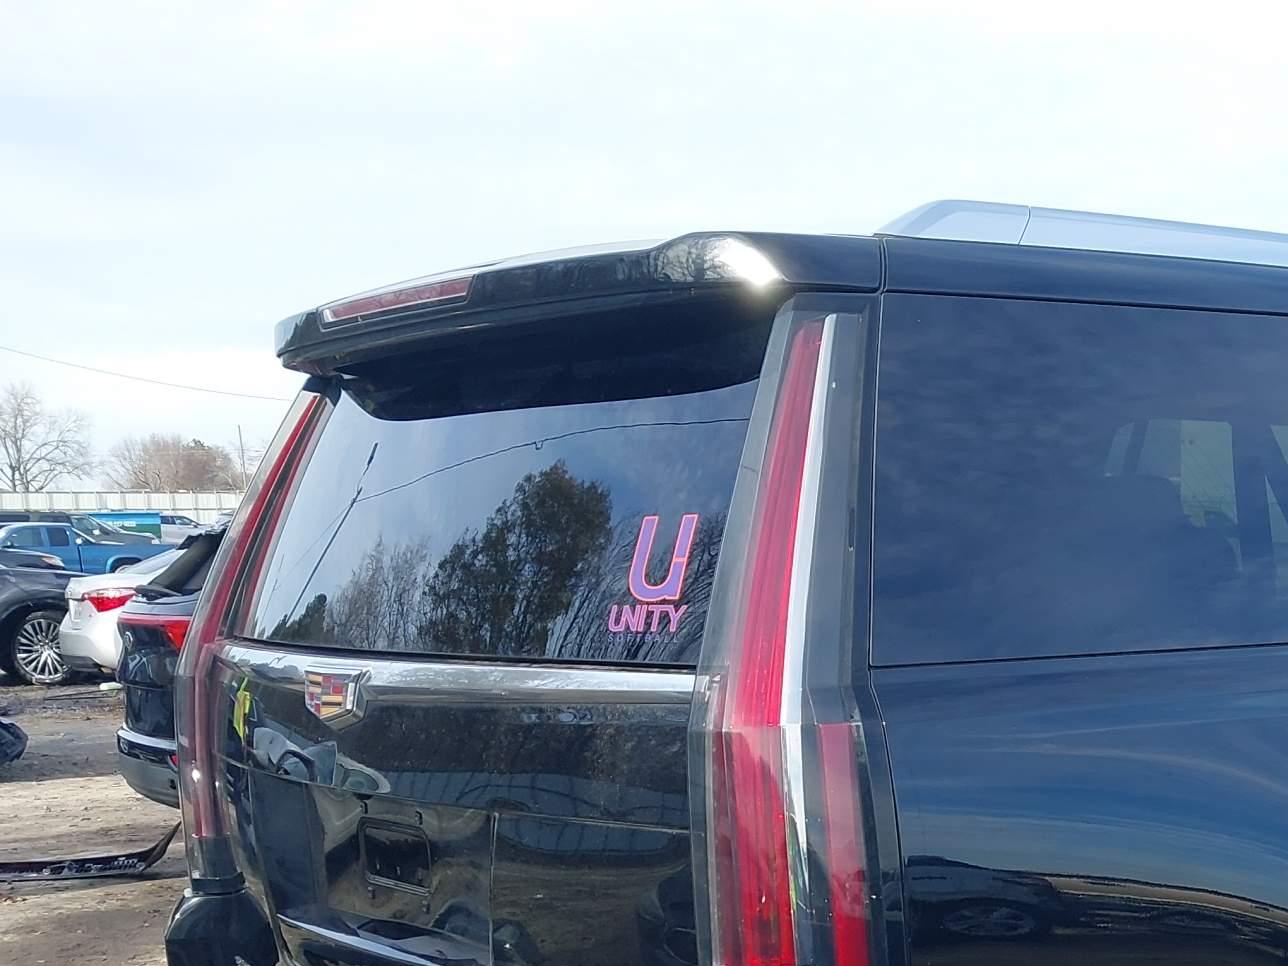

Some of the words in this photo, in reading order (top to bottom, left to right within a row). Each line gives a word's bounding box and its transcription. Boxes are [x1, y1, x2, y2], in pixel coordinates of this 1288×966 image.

[628, 513, 699, 602] U
[608, 604, 689, 632] UNITY
[607, 633, 680, 643] SOFTBALL
